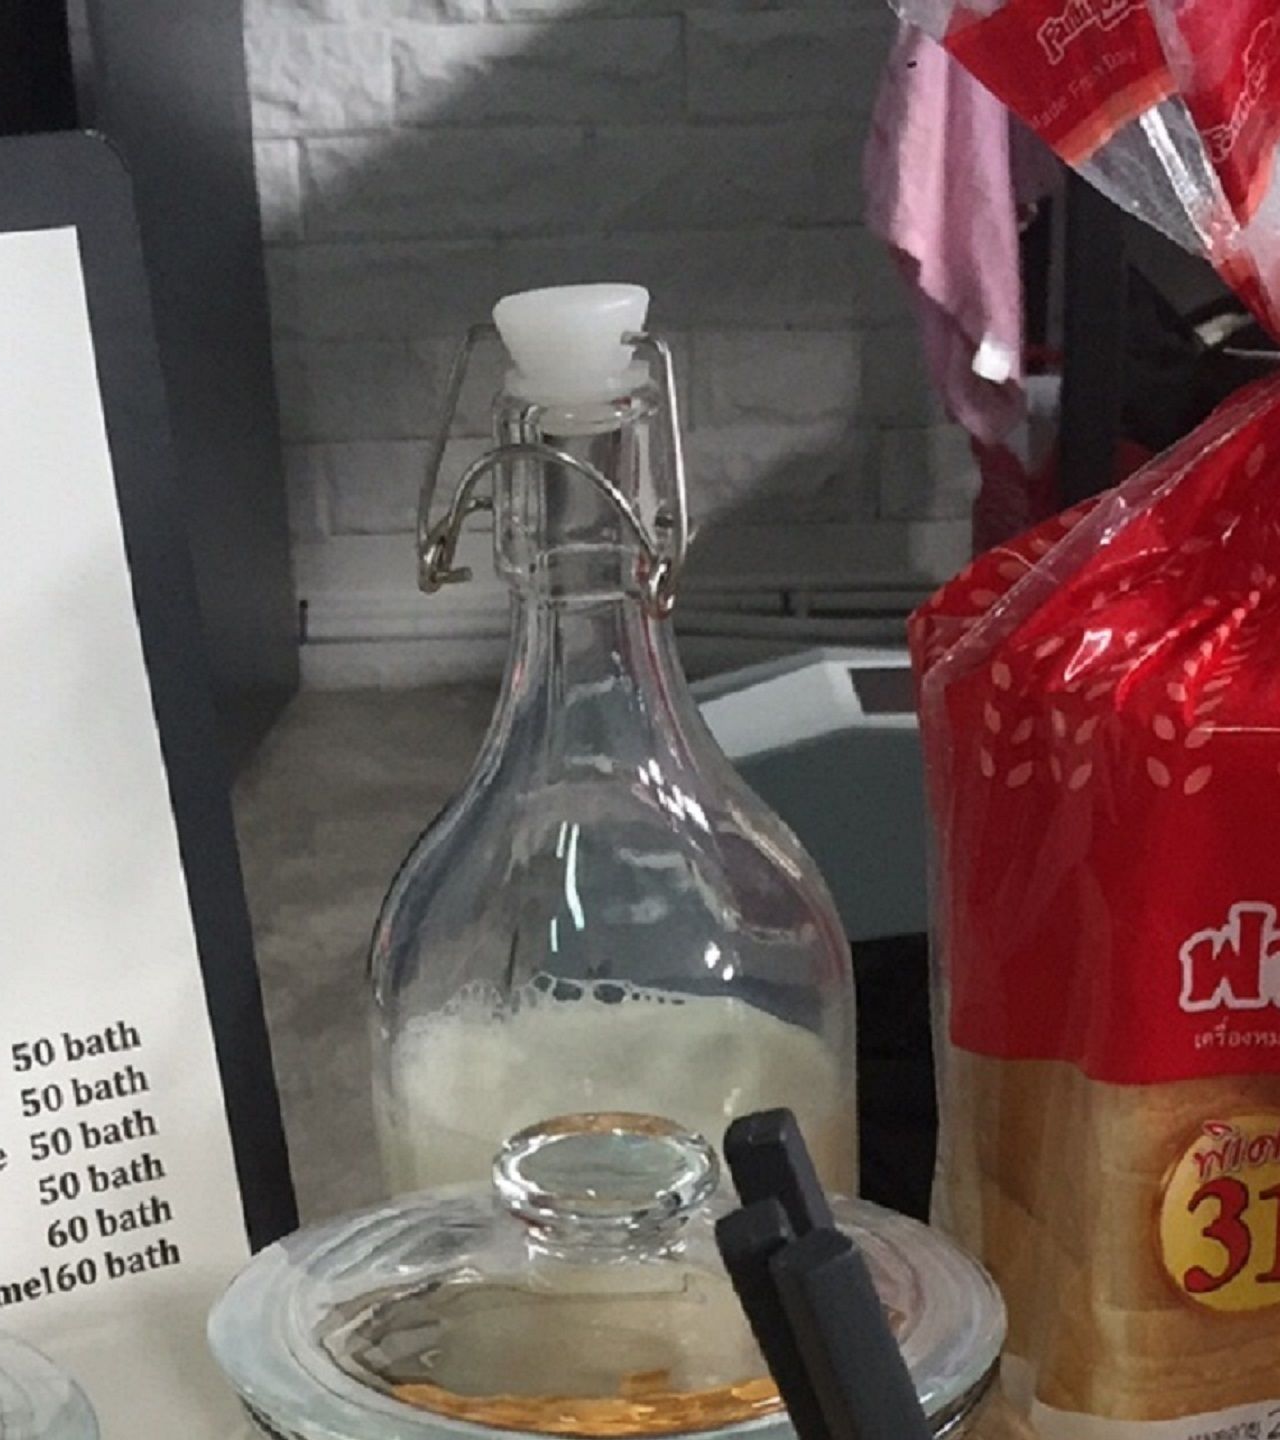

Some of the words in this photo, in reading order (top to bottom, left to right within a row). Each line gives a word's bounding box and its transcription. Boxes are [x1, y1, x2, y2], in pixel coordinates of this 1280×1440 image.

[12, 1039, 55, 1072] 50
[62, 1021, 141, 1061] bath
[21, 1084, 63, 1117] 50
[71, 1065, 149, 1107] bath
[30, 1127, 72, 1161] 50
[78, 1109, 158, 1149] bath
[39, 1172, 80, 1205] 50
[87, 1153, 166, 1192] bath
[48, 1216, 88, 1248] 60
[95, 1195, 172, 1237] bath
[104, 1238, 180, 1279] bath
